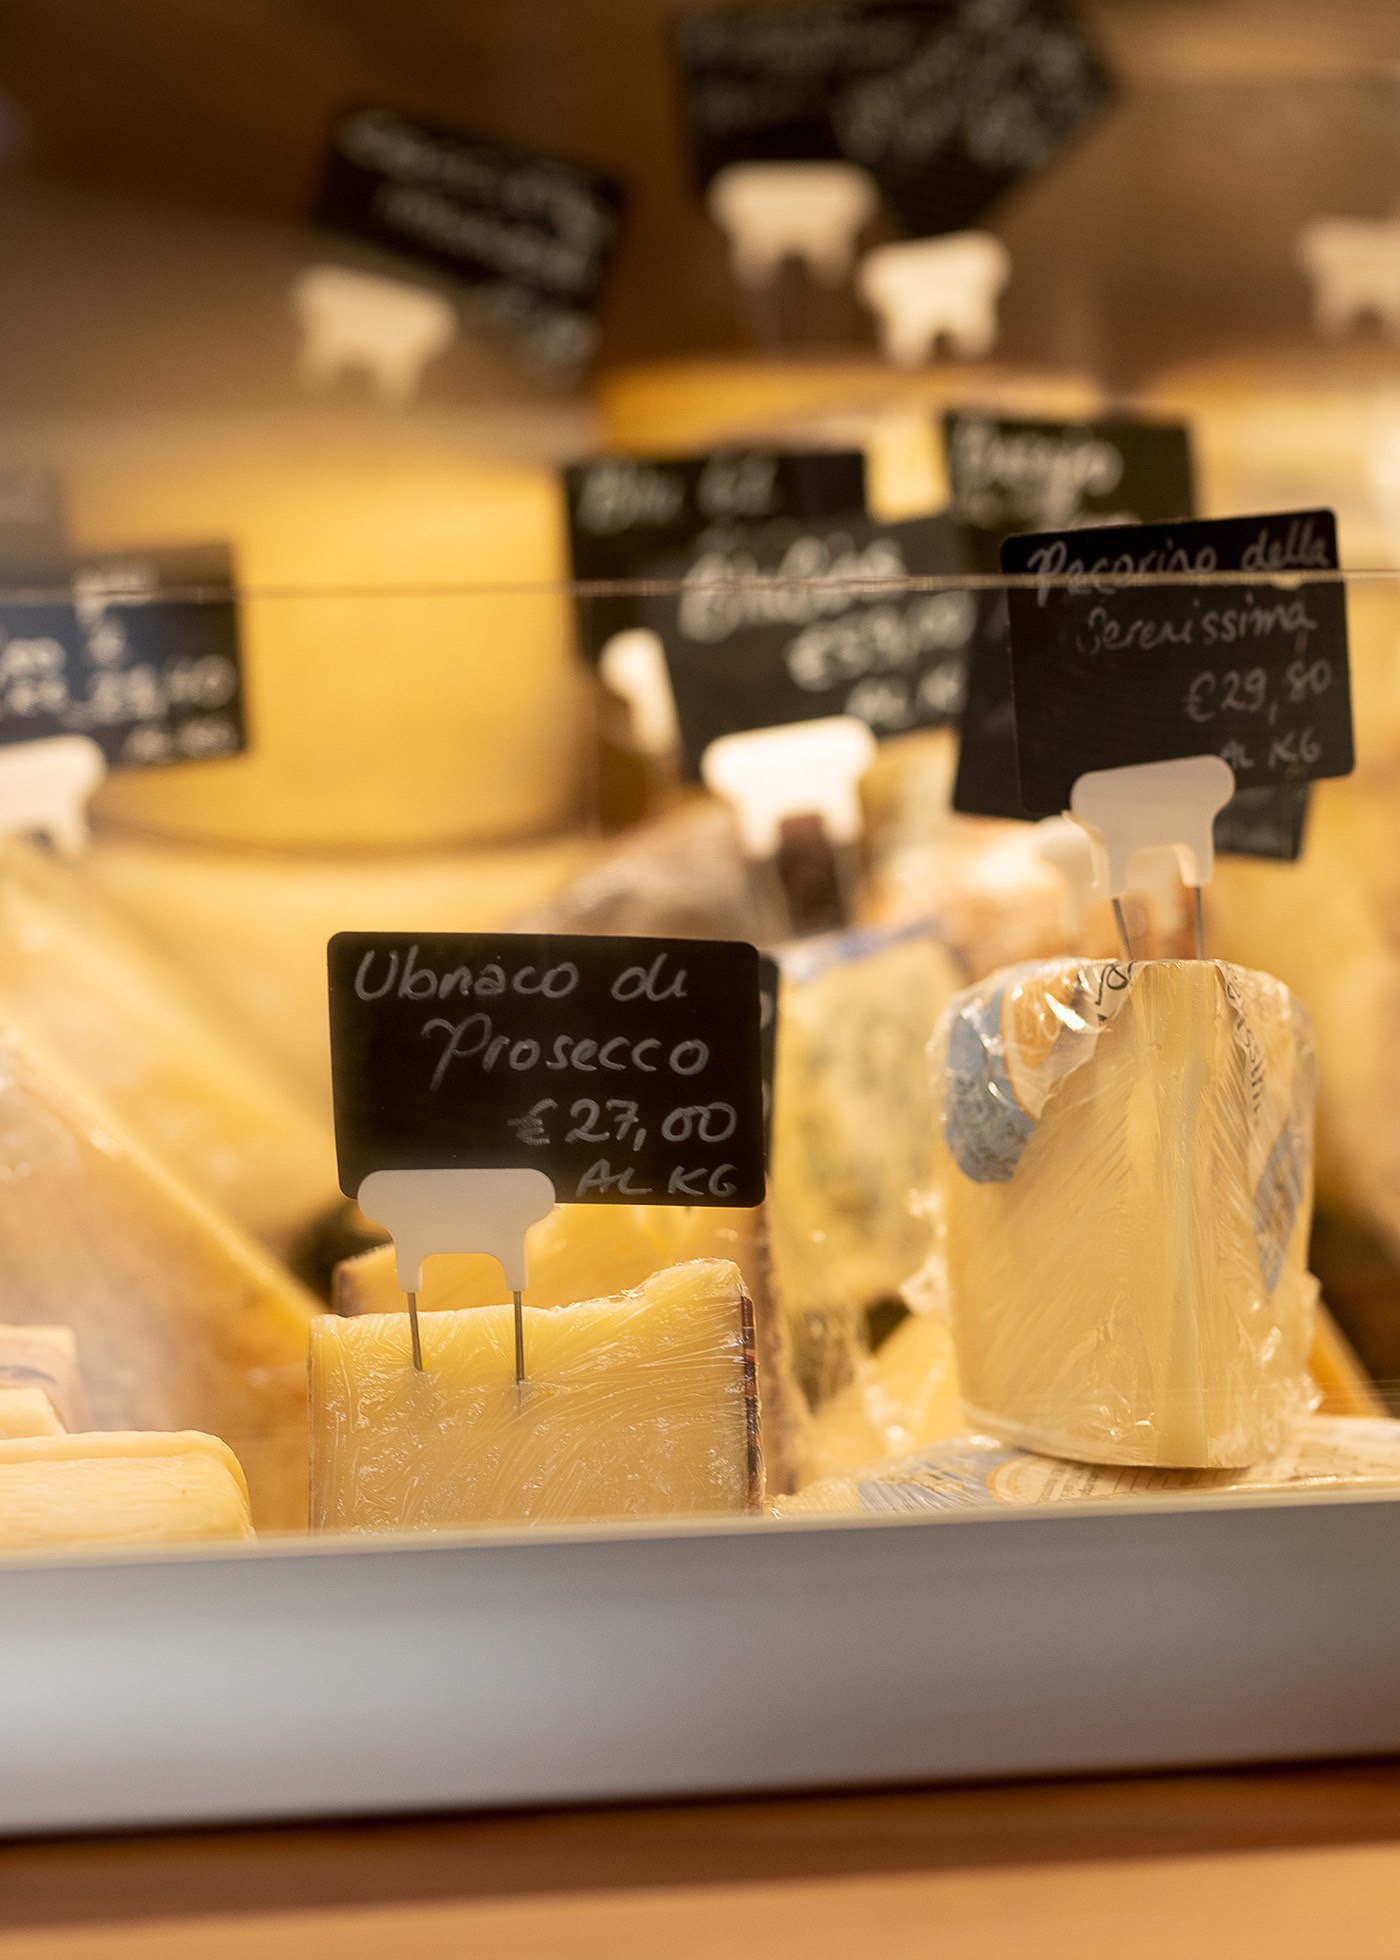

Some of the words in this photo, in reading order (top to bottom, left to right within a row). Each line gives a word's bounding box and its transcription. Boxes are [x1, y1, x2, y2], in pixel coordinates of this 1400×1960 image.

[1240, 519, 1331, 572] della
[1186, 659, 1333, 726] €29,80
[420, 1012, 710, 1093] Prosecco
[574, 1158, 654, 1198] AL
[667, 1162, 738, 1198] KG
